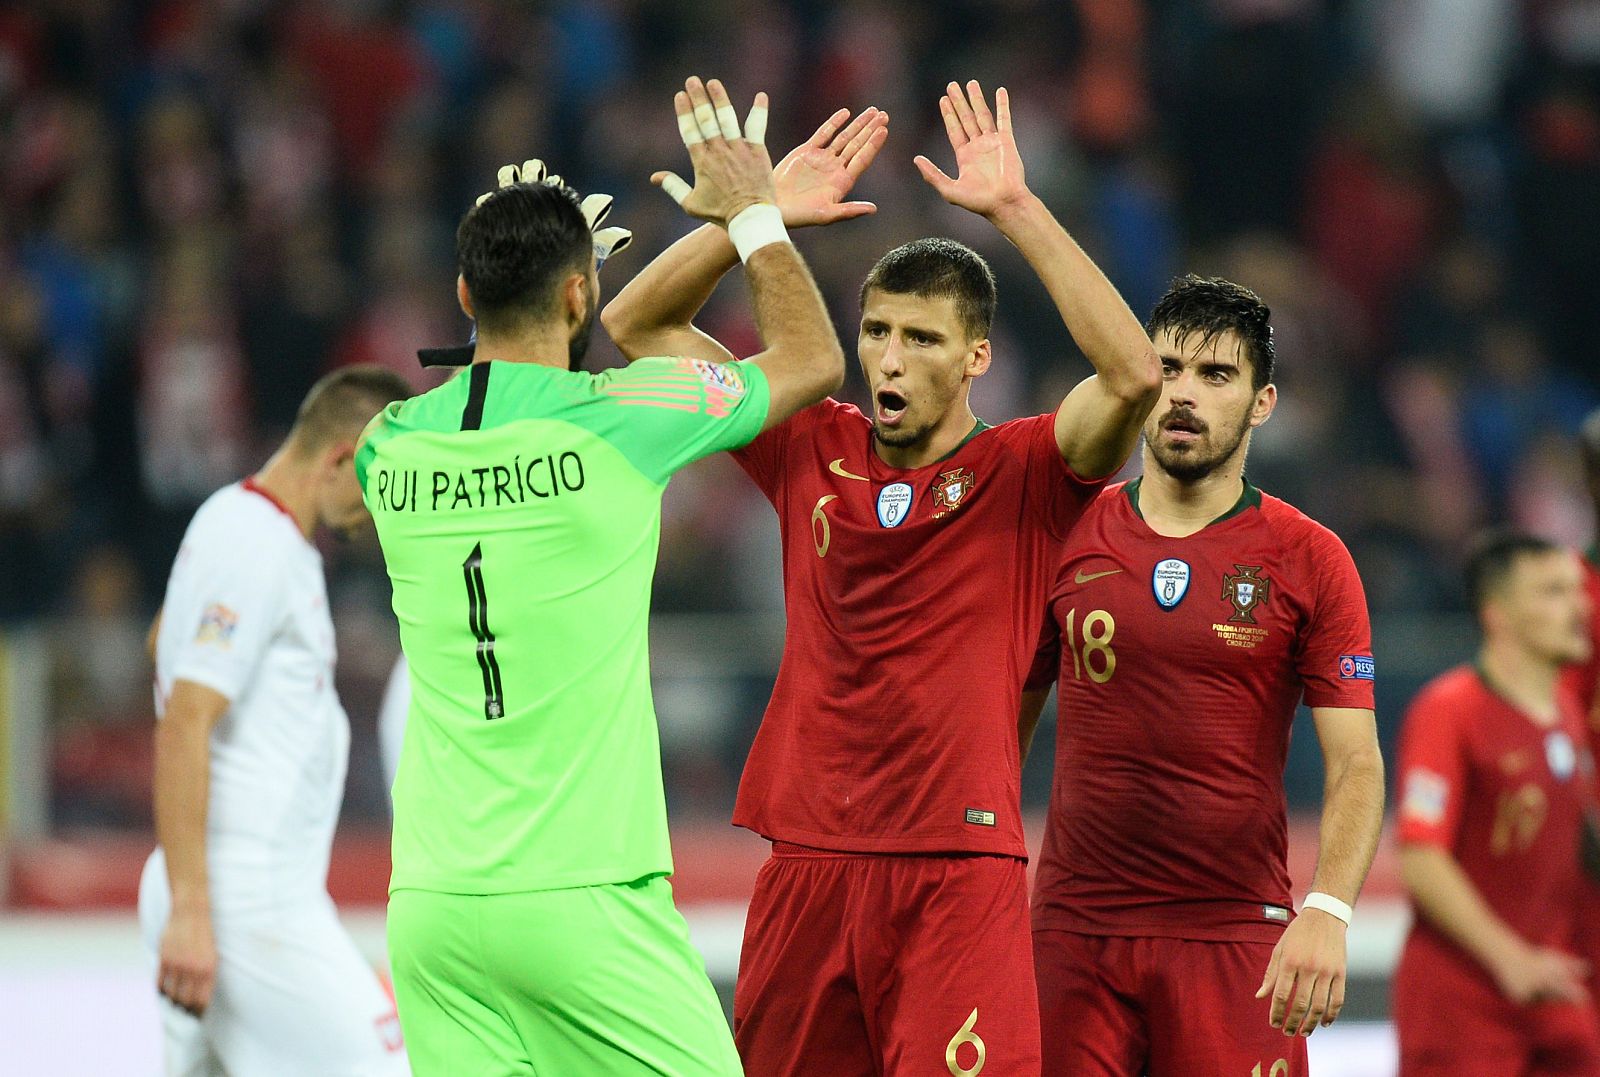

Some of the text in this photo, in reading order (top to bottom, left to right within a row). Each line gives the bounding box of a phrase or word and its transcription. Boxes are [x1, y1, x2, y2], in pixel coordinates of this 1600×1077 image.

[377, 450, 586, 513] RUI PATRÍCIO
[811, 494, 839, 558] 6
[462, 541, 505, 721] 1
[1066, 607, 1117, 684] 18
[945, 1007, 987, 1077] 6
